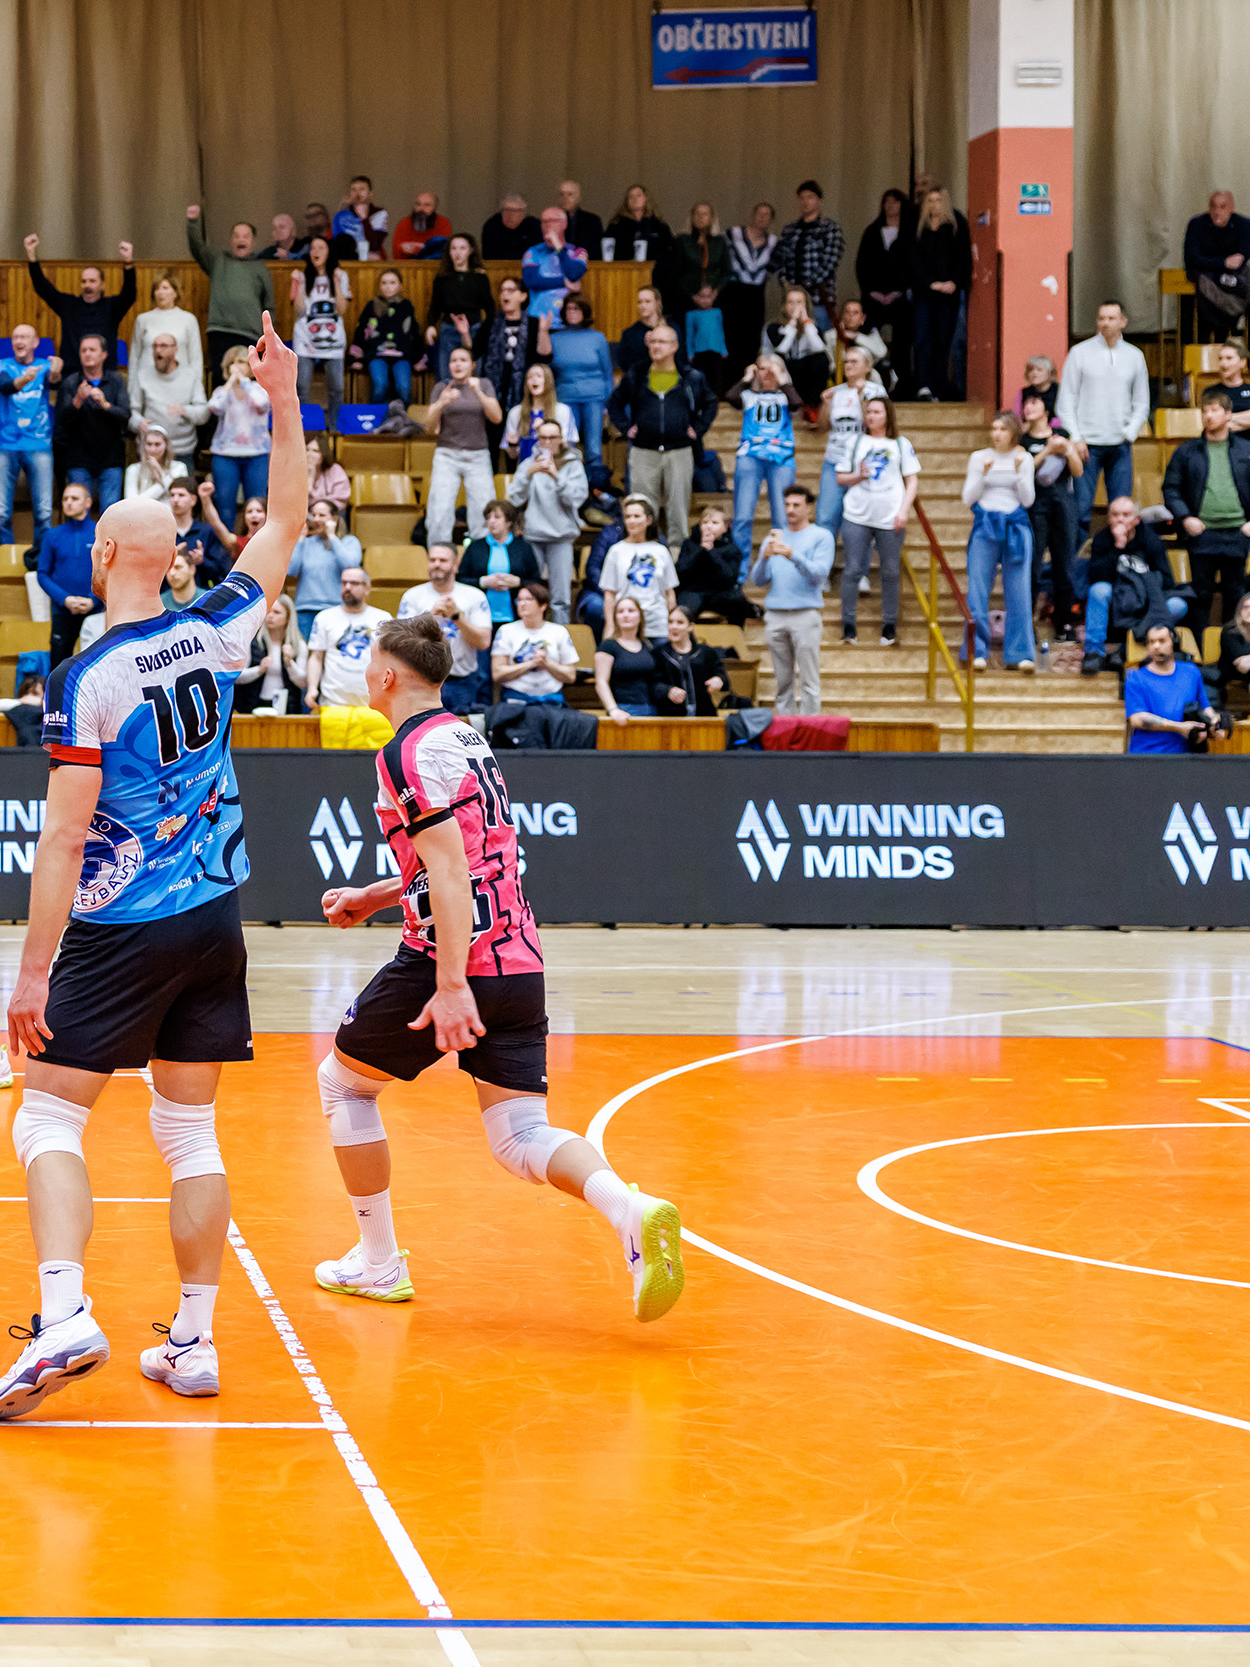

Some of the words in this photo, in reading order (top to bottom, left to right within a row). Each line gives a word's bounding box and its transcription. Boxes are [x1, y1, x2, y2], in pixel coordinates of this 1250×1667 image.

[657, 15, 811, 52] OBČERSTVENÍ
[134, 635, 206, 674] SVOBODA
[141, 667, 221, 767] 10
[465, 756, 515, 829] 16
[798, 803, 1006, 839] WINNING
[803, 844, 955, 880] MINDS
